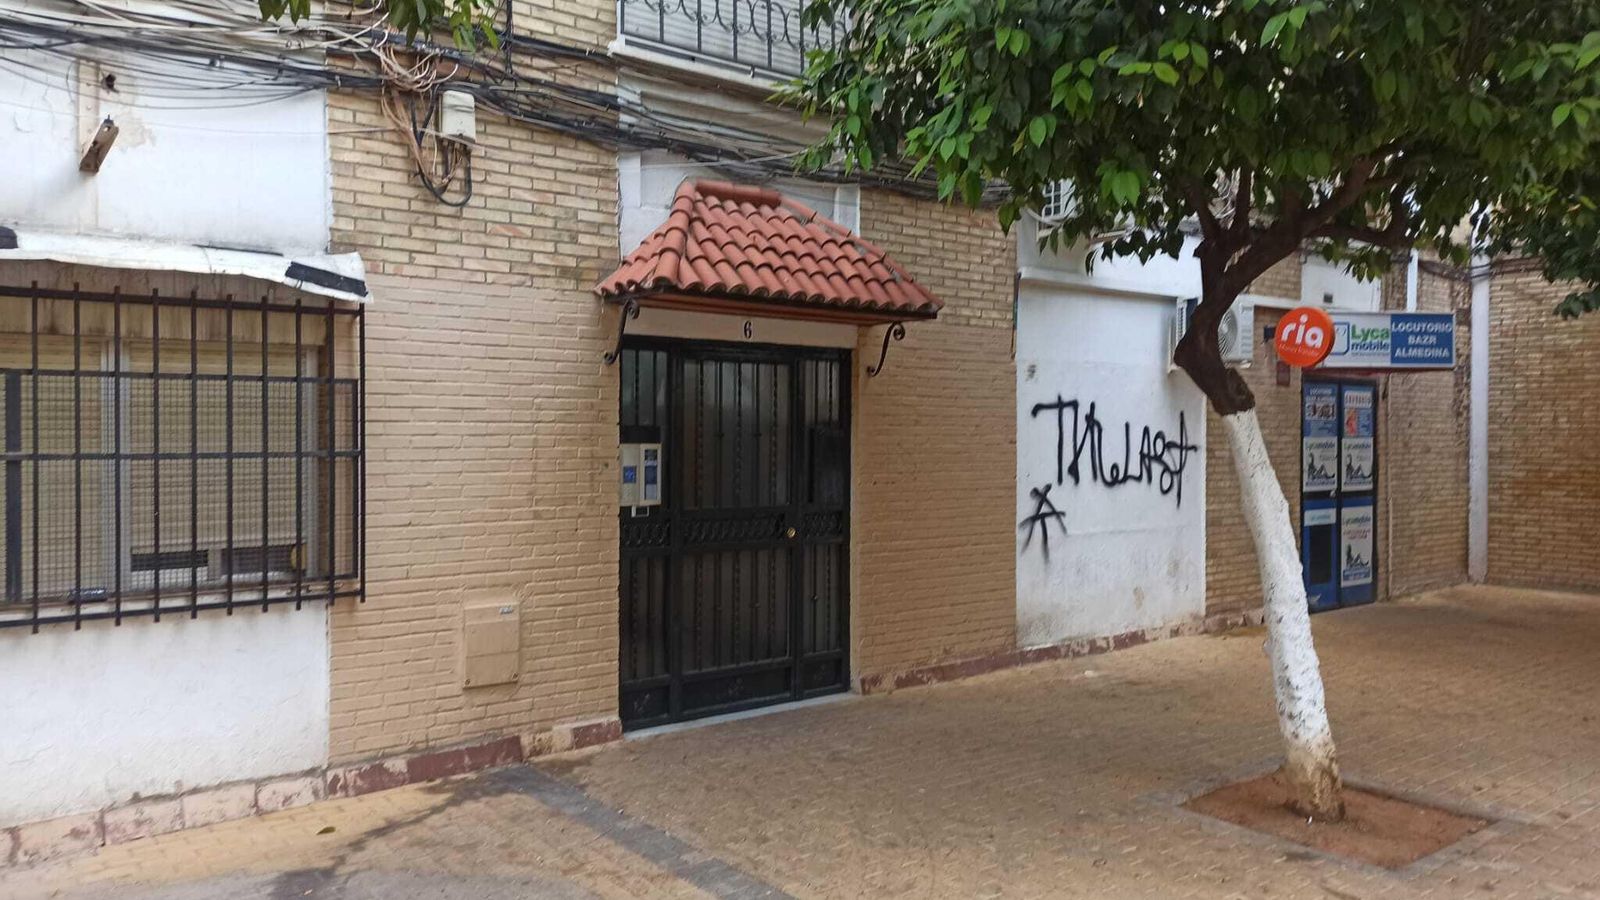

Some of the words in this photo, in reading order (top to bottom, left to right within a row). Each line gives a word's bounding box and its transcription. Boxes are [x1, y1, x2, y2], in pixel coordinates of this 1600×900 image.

[743, 320, 752, 339] 6
[1281, 313, 1324, 348] ria
[1351, 325, 1390, 343] Lyca
[1391, 321, 1453, 333] LOCUTORIO
[1351, 340, 1390, 351] mobile
[1394, 347, 1450, 358] ALMEDINA
